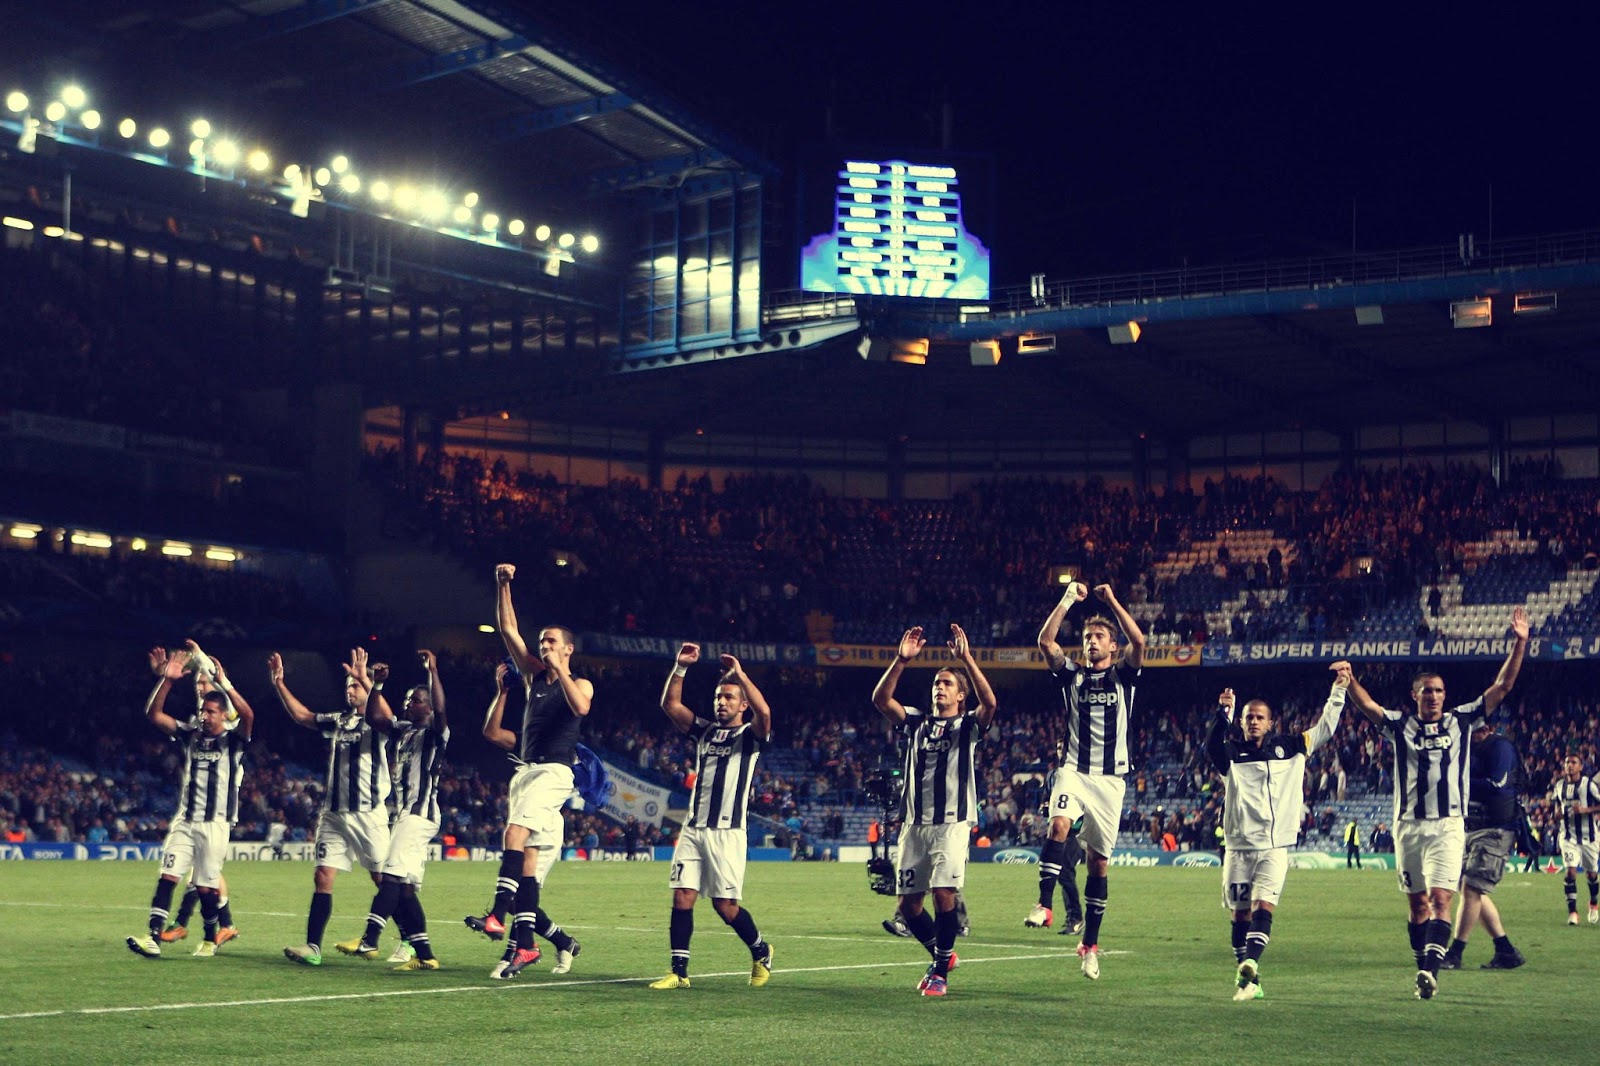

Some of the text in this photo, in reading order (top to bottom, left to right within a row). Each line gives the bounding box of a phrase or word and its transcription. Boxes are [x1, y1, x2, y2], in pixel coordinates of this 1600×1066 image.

[1250, 643, 1314, 660] SUPER
[1320, 641, 1411, 657] FRANKIE
[1529, 639, 1540, 657] 8
[1079, 689, 1118, 707] Jeep
[702, 741, 732, 757] Jeep
[920, 737, 951, 752] Jeep
[1414, 735, 1452, 751] Jeep
[1058, 794, 1069, 809] 8
[34, 851, 64, 859] SONY
[671, 863, 684, 882] 27
[1402, 870, 1413, 888] 3
[1230, 882, 1250, 901] 12
